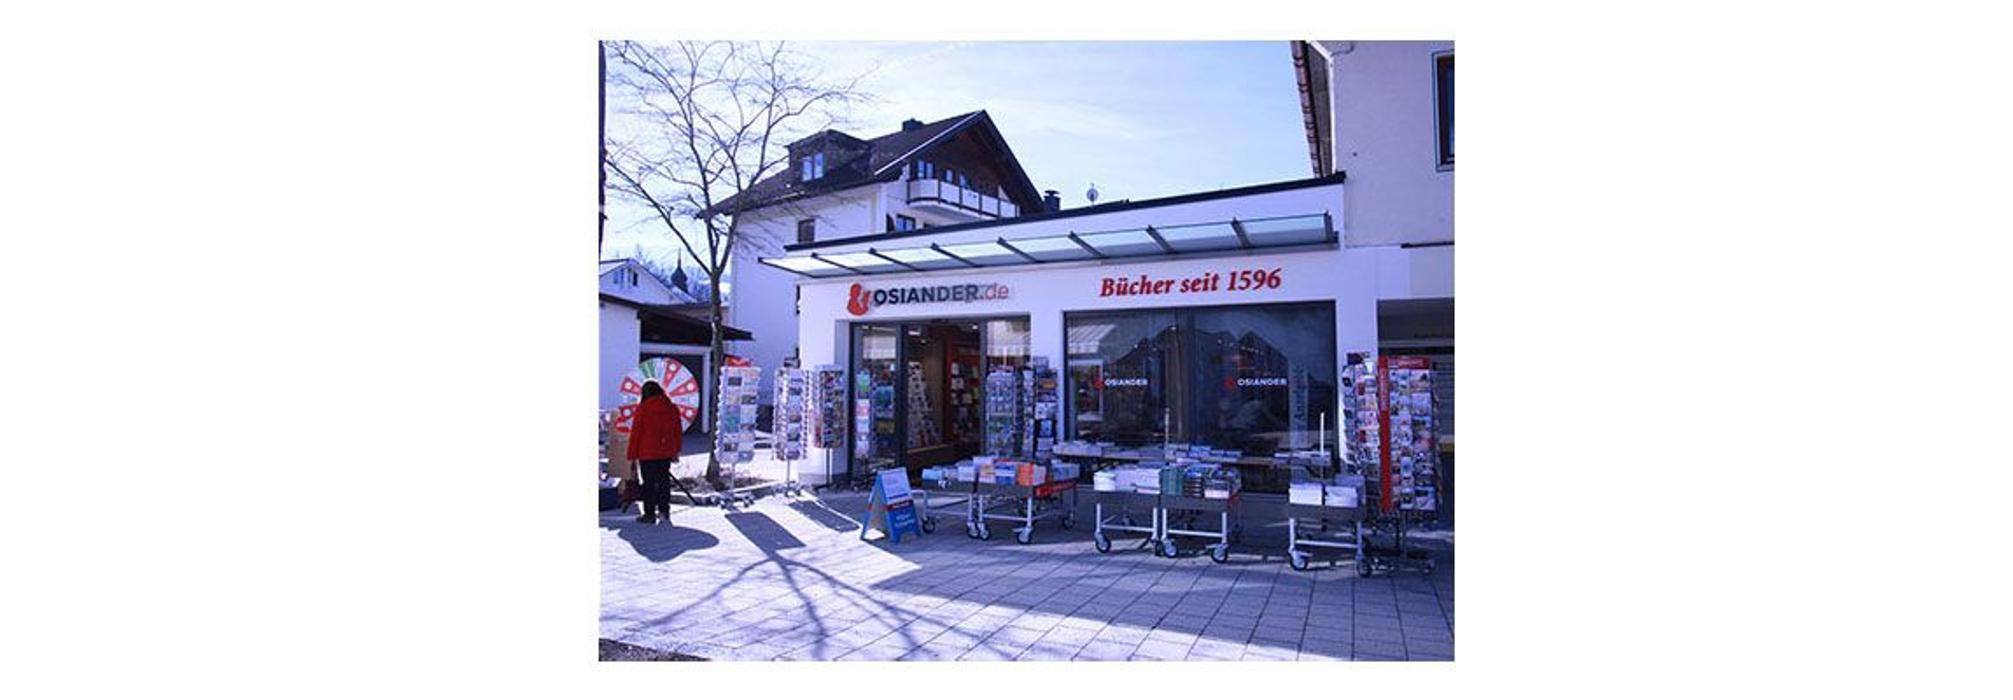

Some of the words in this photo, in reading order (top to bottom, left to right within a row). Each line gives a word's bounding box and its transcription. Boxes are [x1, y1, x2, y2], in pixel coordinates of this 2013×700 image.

[1100, 274, 1174, 297] Bücher
[1179, 272, 1221, 292] seit
[1226, 267, 1283, 291] 1596
[1104, 378, 1149, 386] OSIANDER
[1237, 377, 1287, 386] OSIANDER
